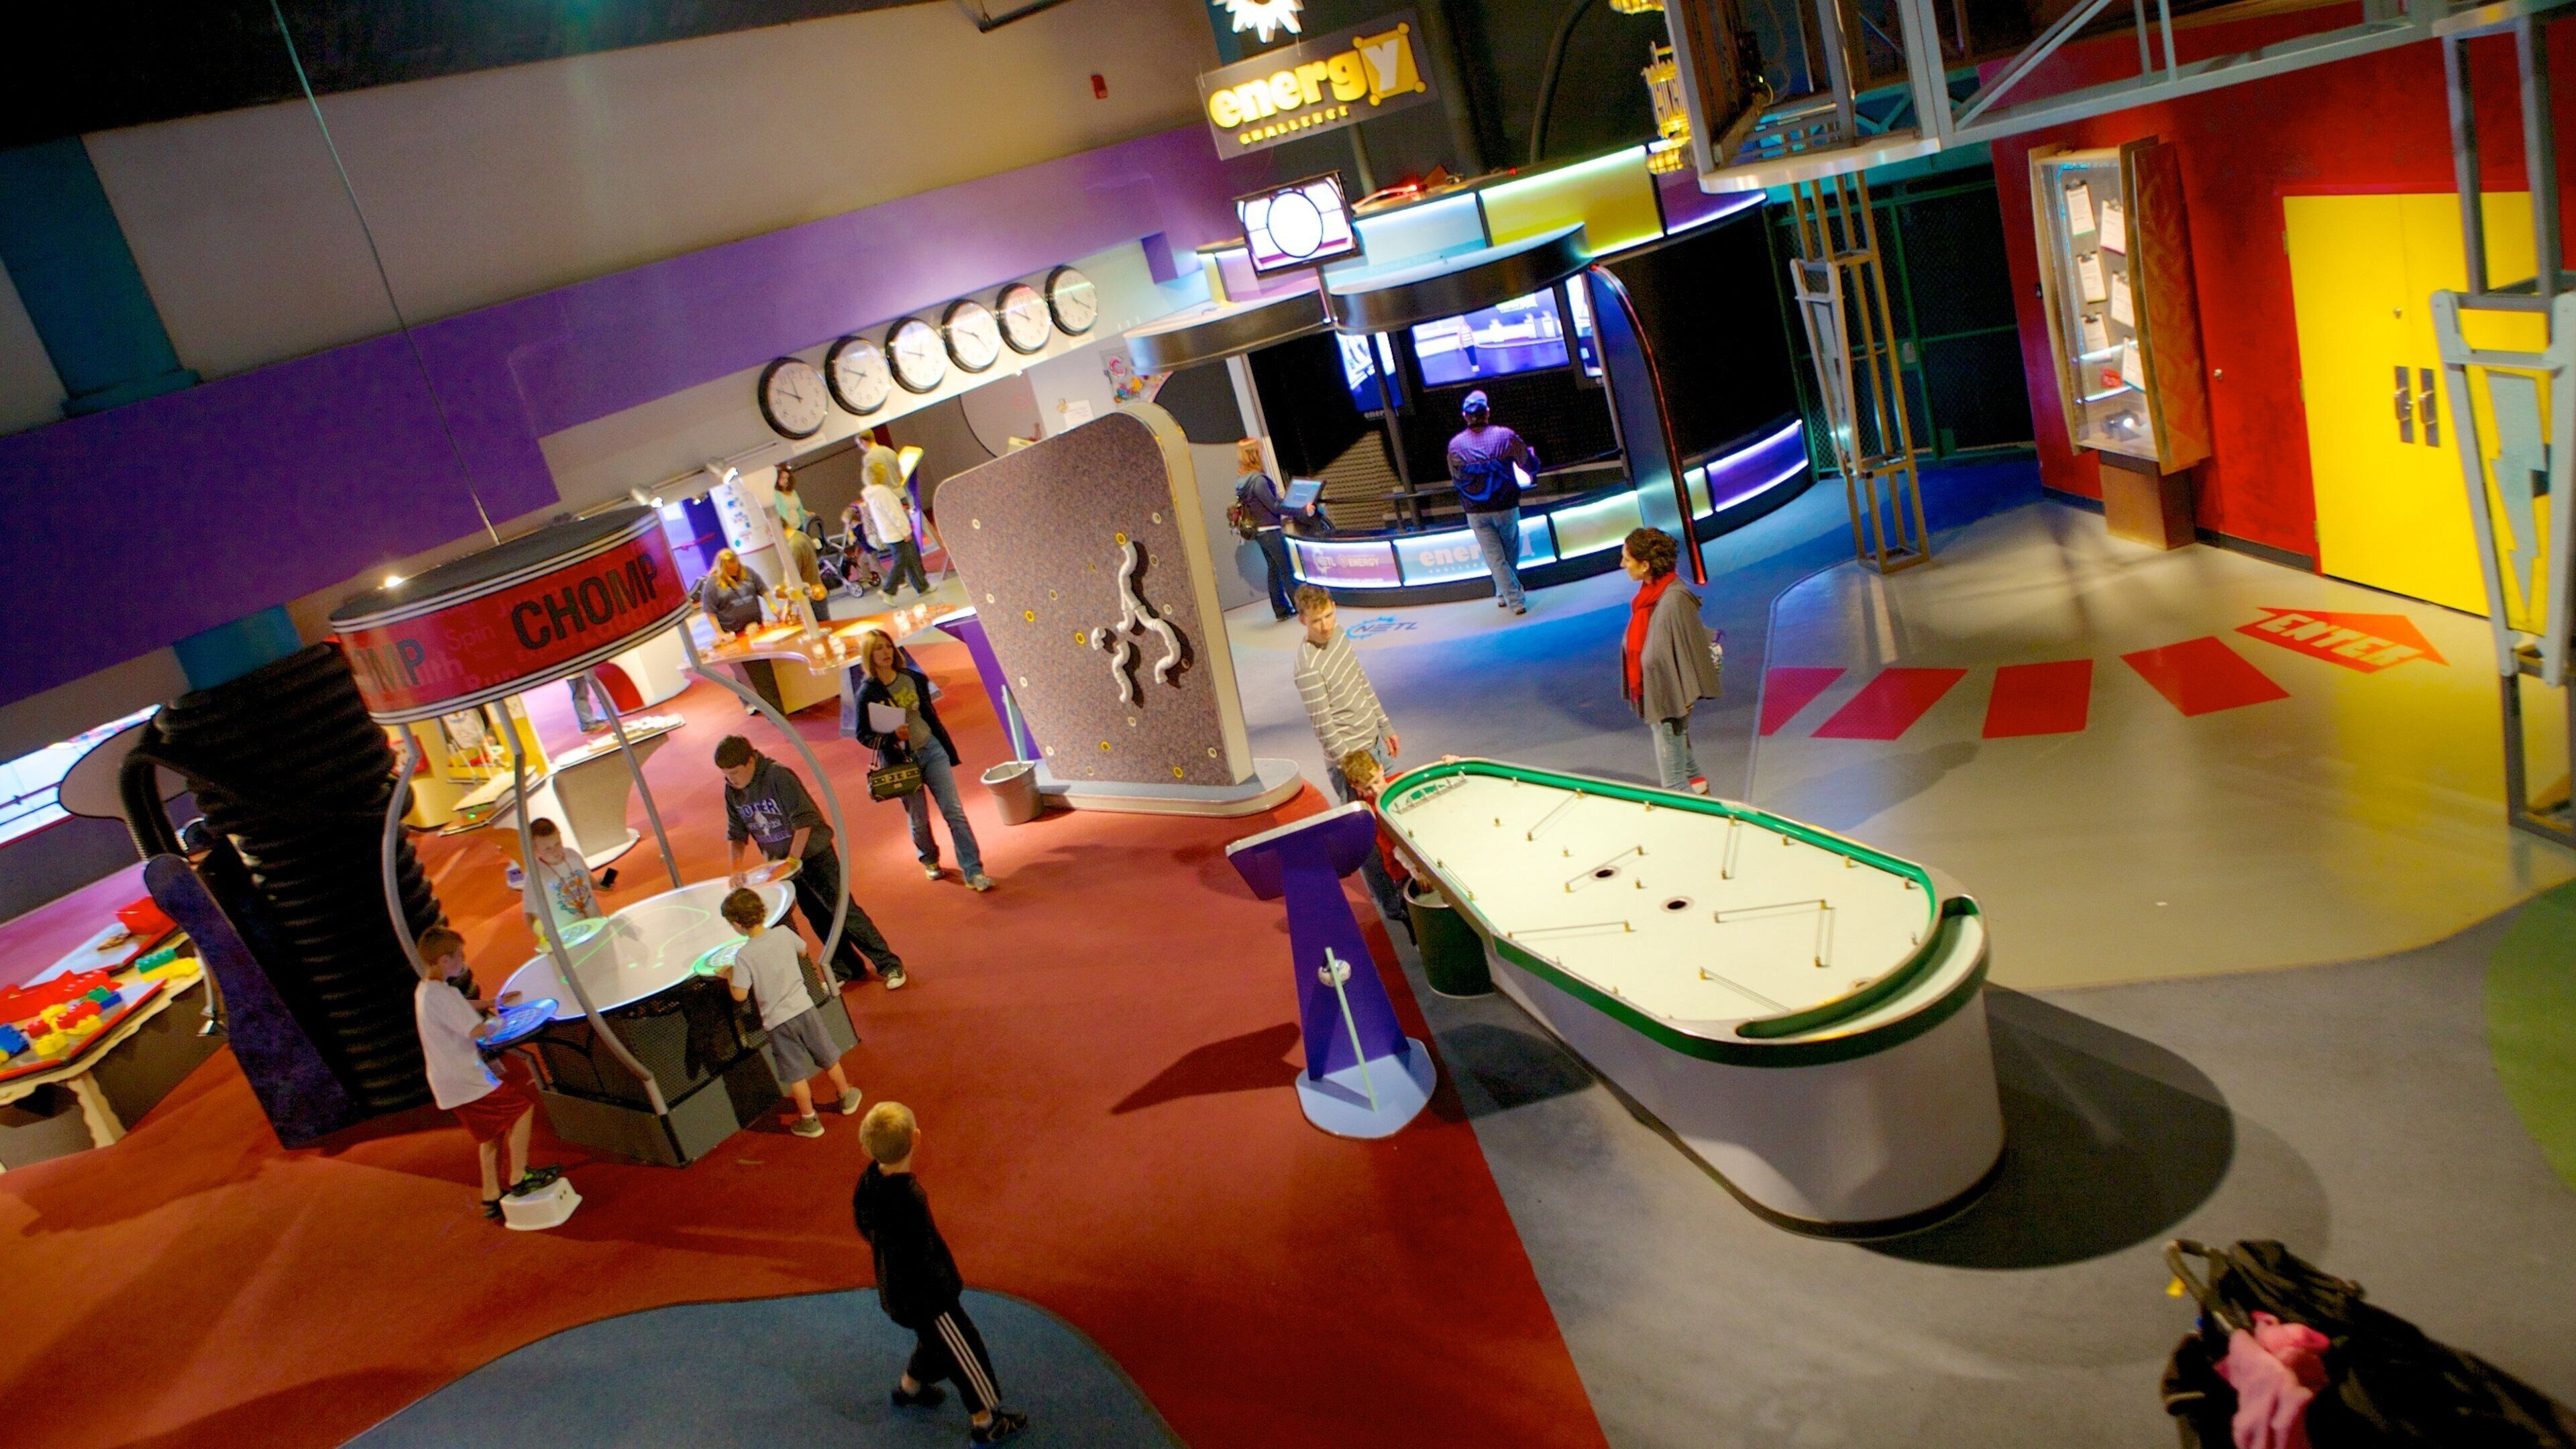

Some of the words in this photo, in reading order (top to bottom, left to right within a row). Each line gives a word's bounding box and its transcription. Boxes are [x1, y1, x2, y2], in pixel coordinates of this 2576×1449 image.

[511, 553, 657, 649] CHOMP
[1354, 621, 1417, 633] NETL
[2255, 613, 2424, 666] ENTER
